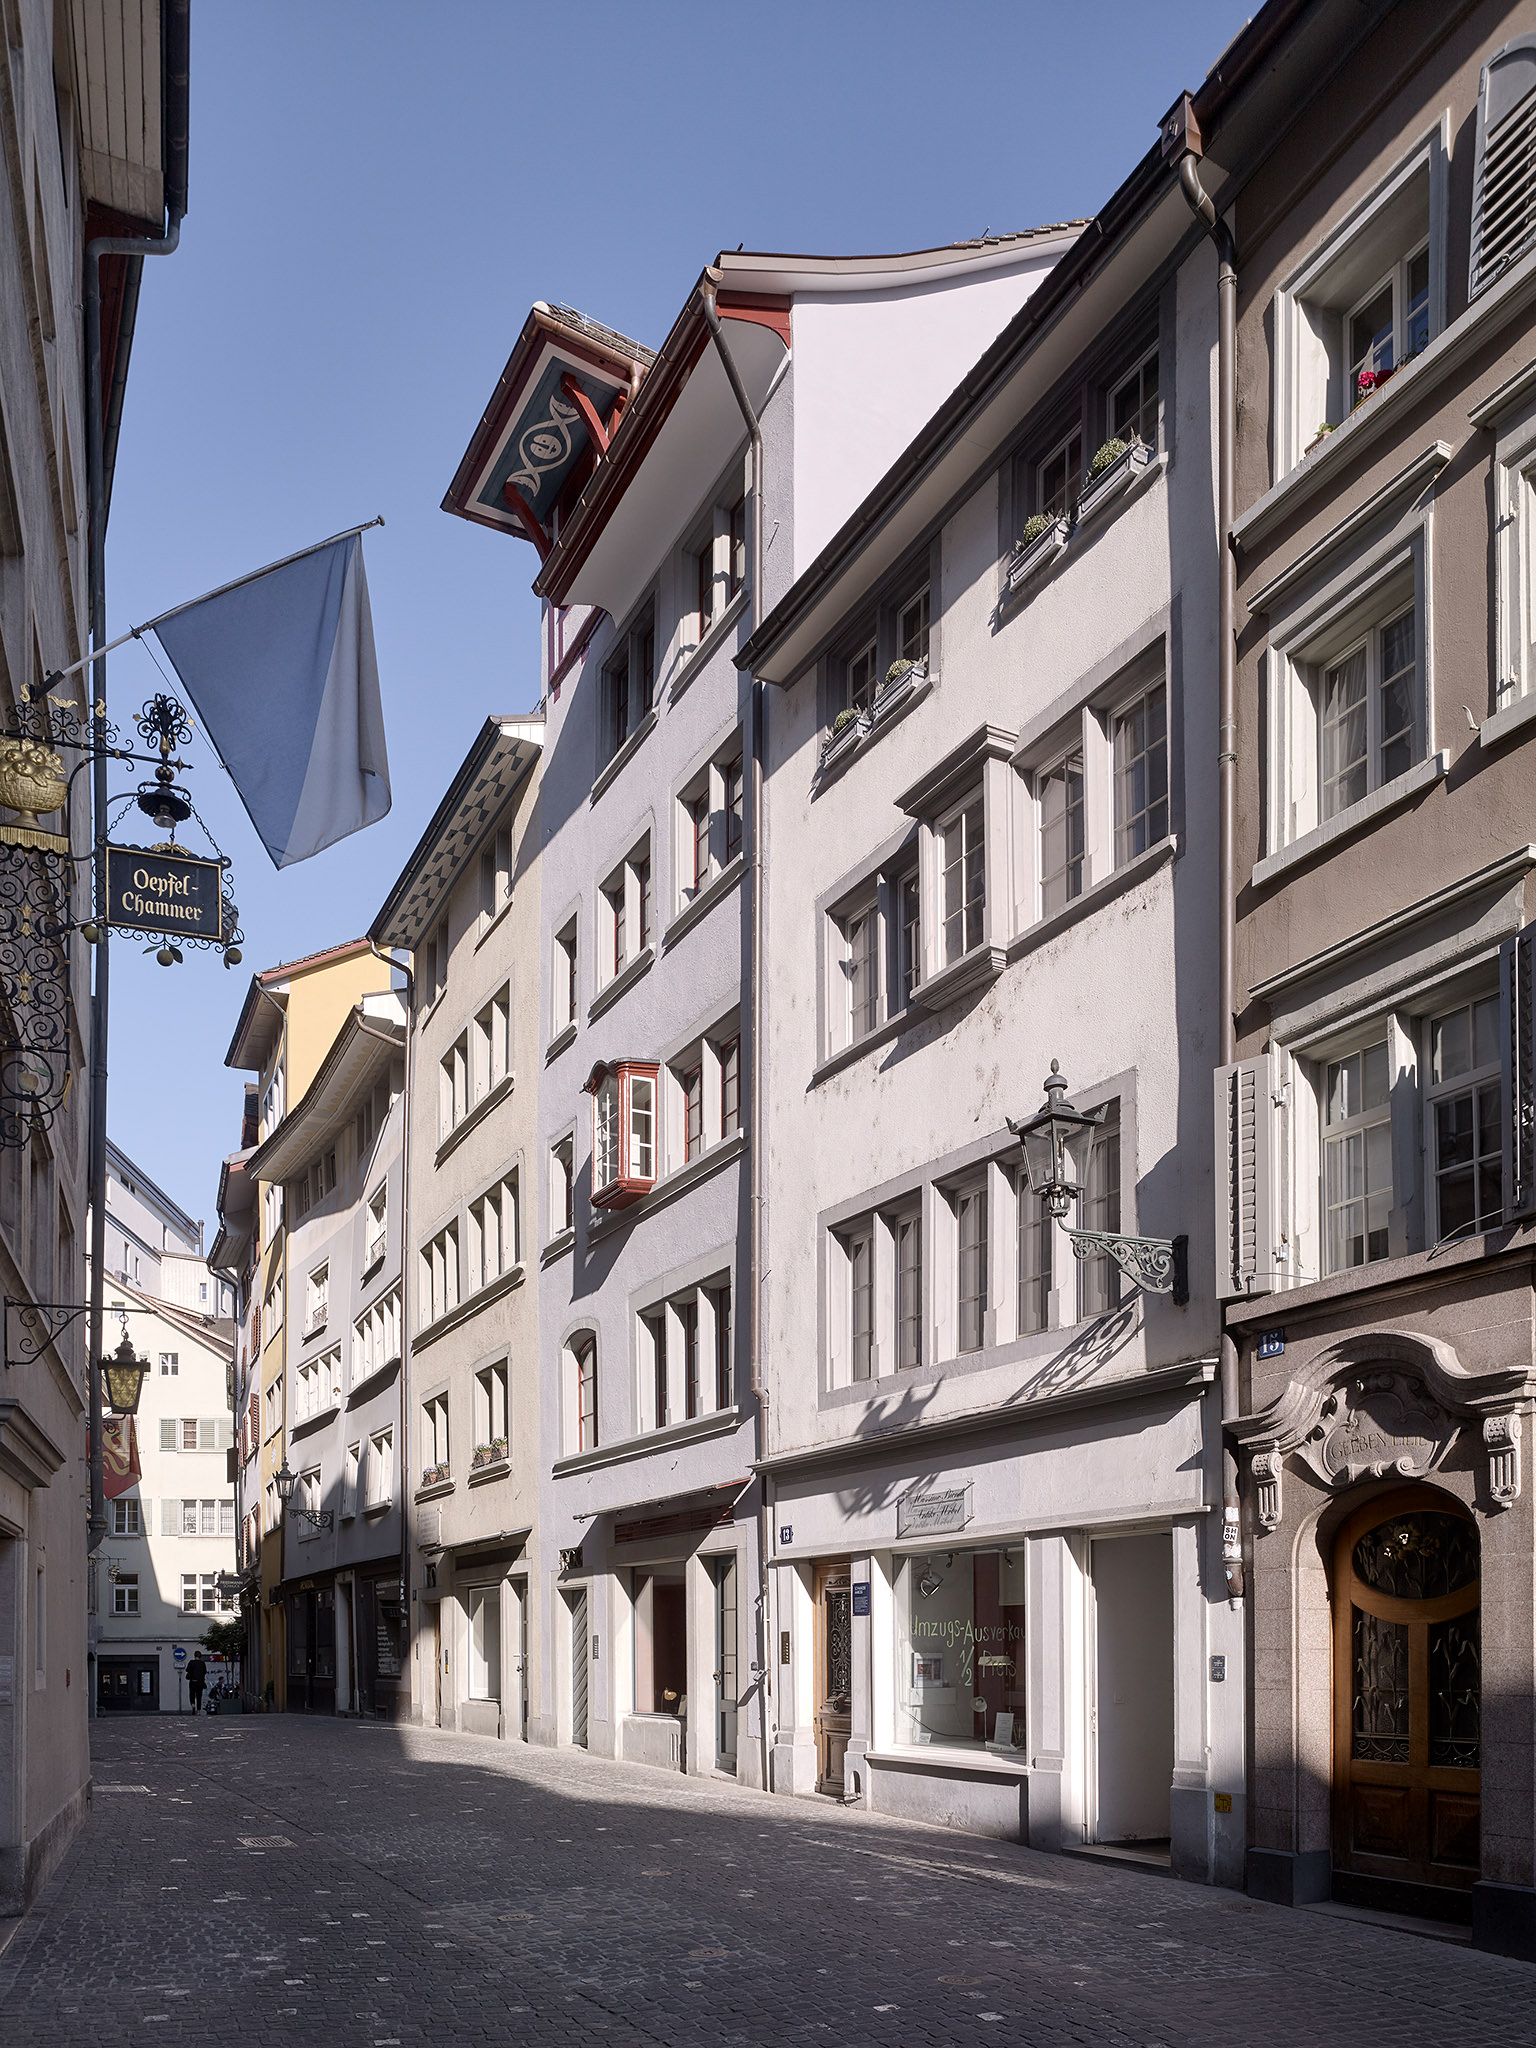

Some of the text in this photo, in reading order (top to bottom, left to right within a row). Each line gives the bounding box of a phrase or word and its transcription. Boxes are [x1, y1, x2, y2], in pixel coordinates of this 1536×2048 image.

[133, 868, 199, 898] Oepfel-
[121, 891, 203, 921] Chammer
[1262, 1332, 1280, 1354] 15
[782, 1528, 790, 1541] 13
